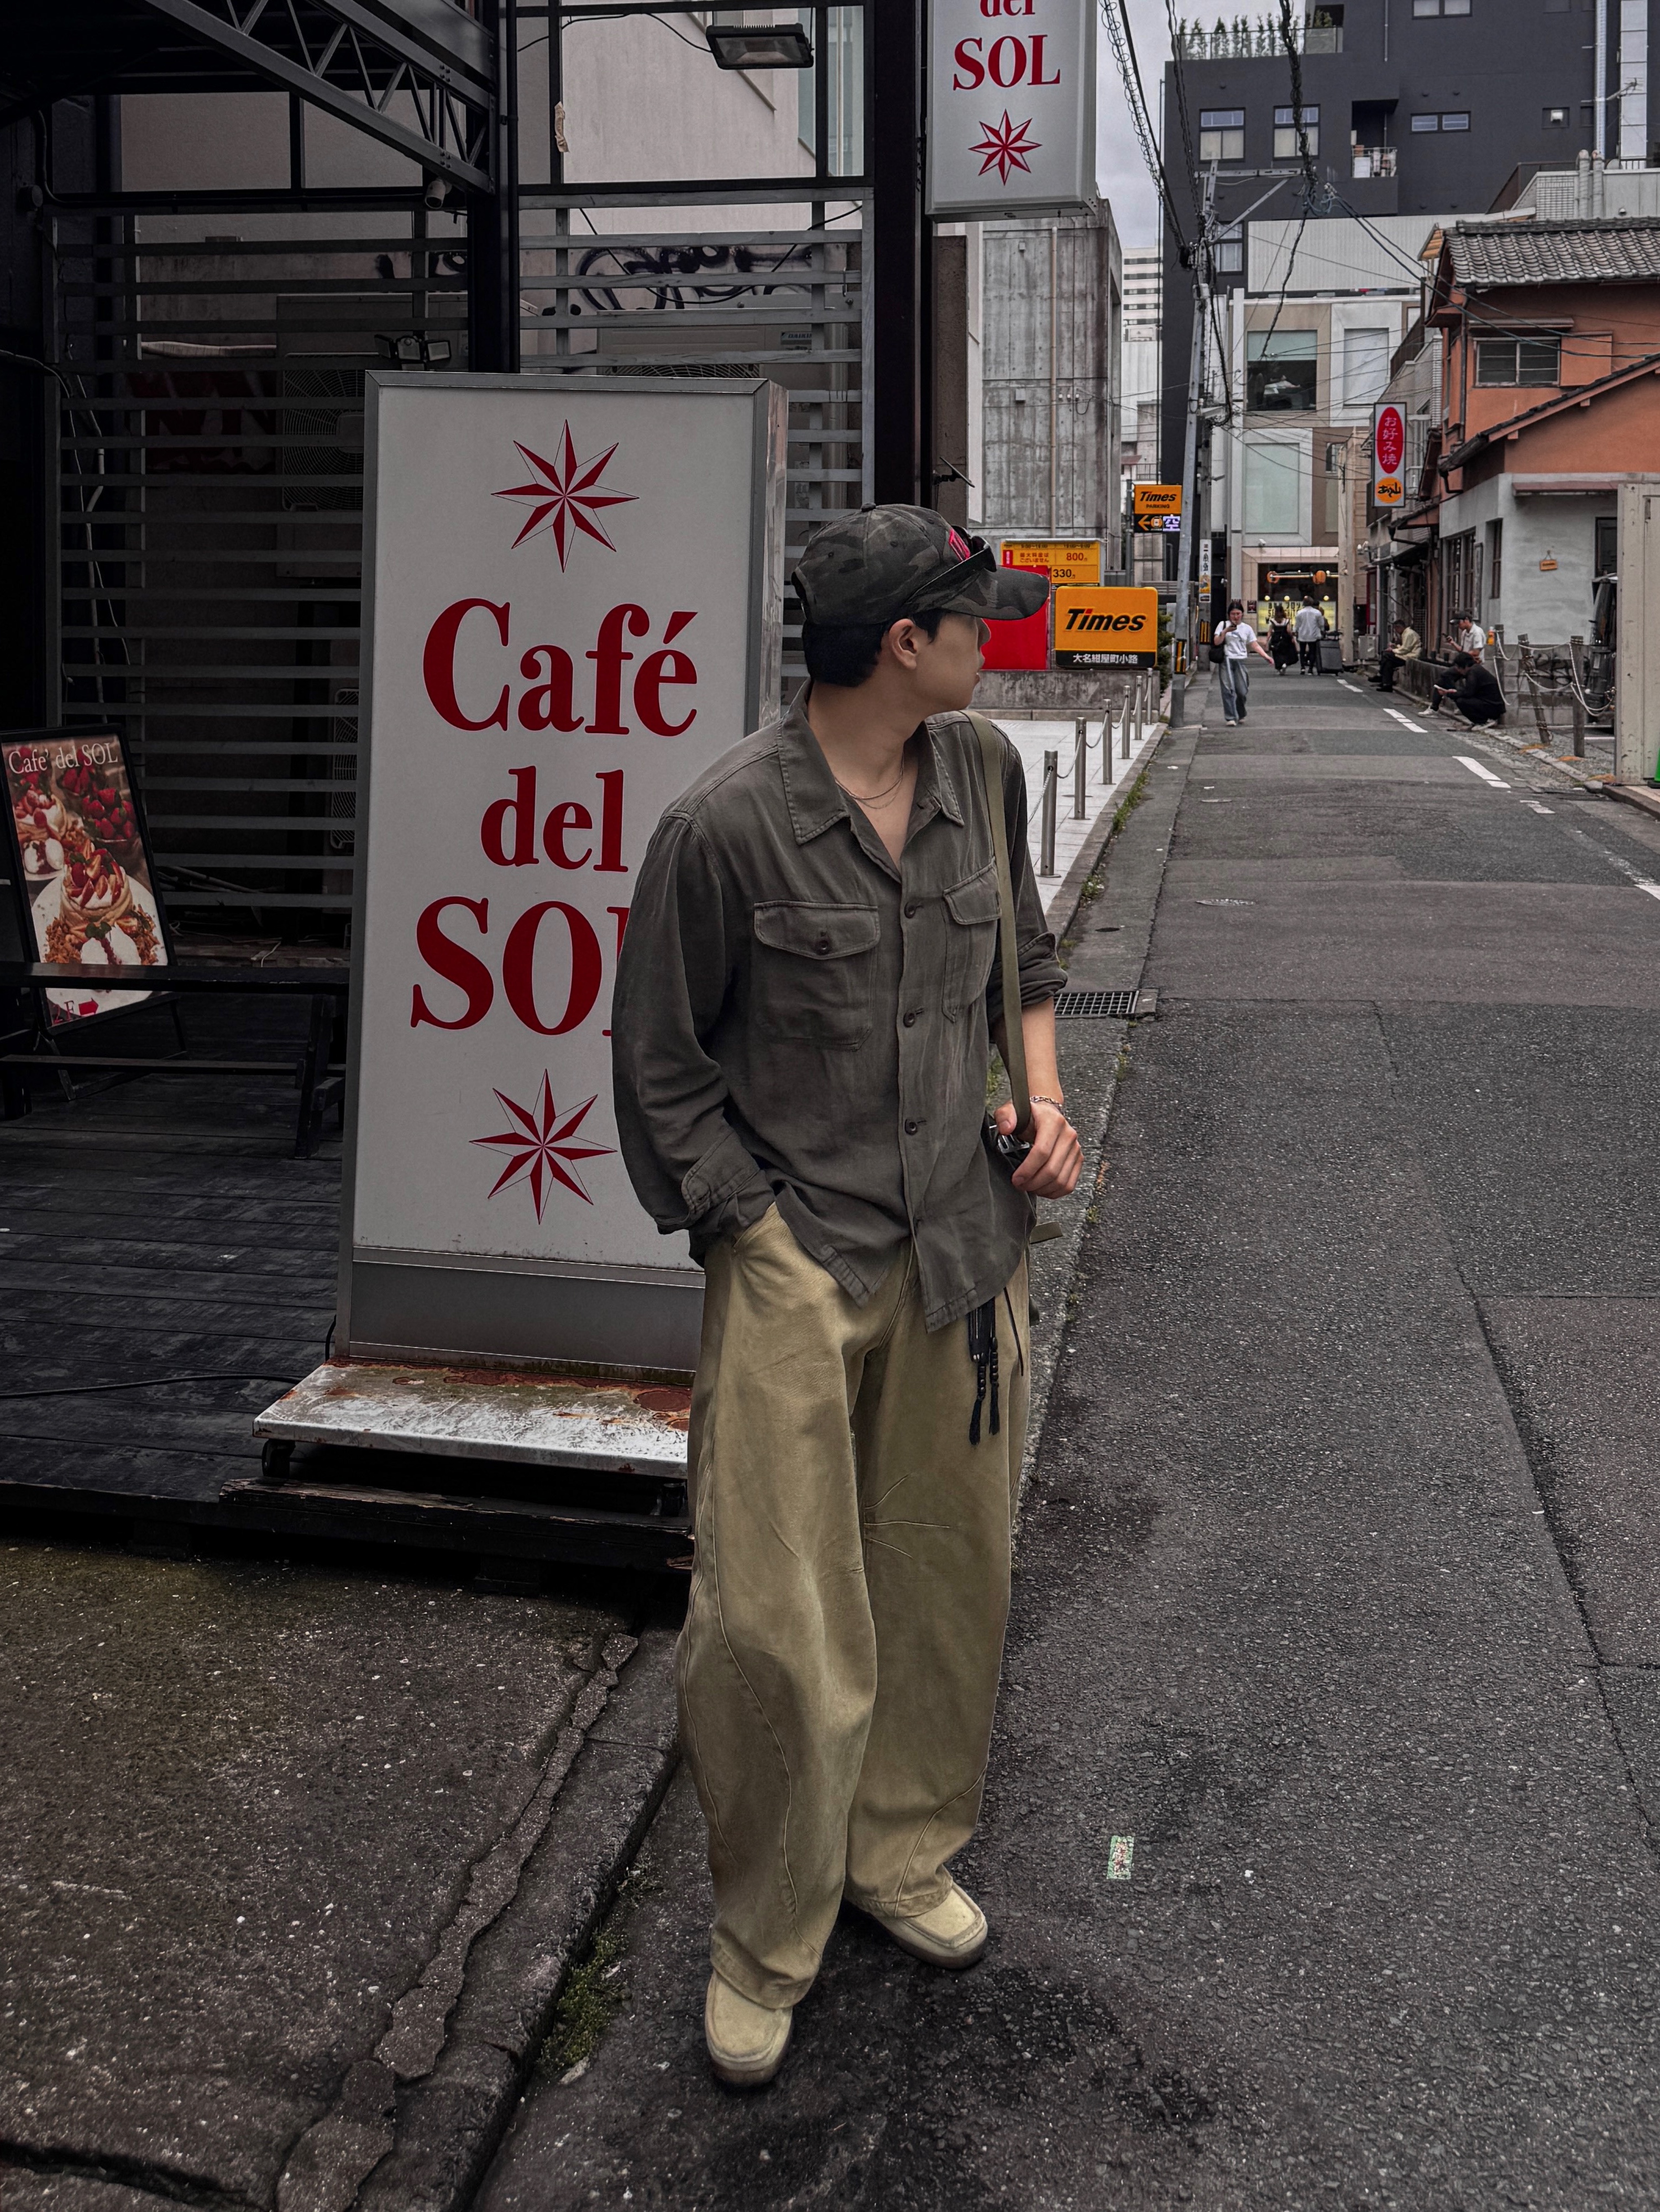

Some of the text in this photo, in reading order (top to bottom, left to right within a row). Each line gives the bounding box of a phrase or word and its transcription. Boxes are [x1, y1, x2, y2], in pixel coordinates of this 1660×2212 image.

[953, 34, 1060, 91] SOL
[1383, 416, 1399, 465] お好み焼
[1140, 491, 1177, 501] Times
[1162, 513, 1181, 532] 空
[1065, 609, 1146, 631] Times
[423, 597, 698, 737] Café
[56, 746, 80, 769] del
[82, 742, 118, 766] SOL
[480, 766, 629, 872] del
